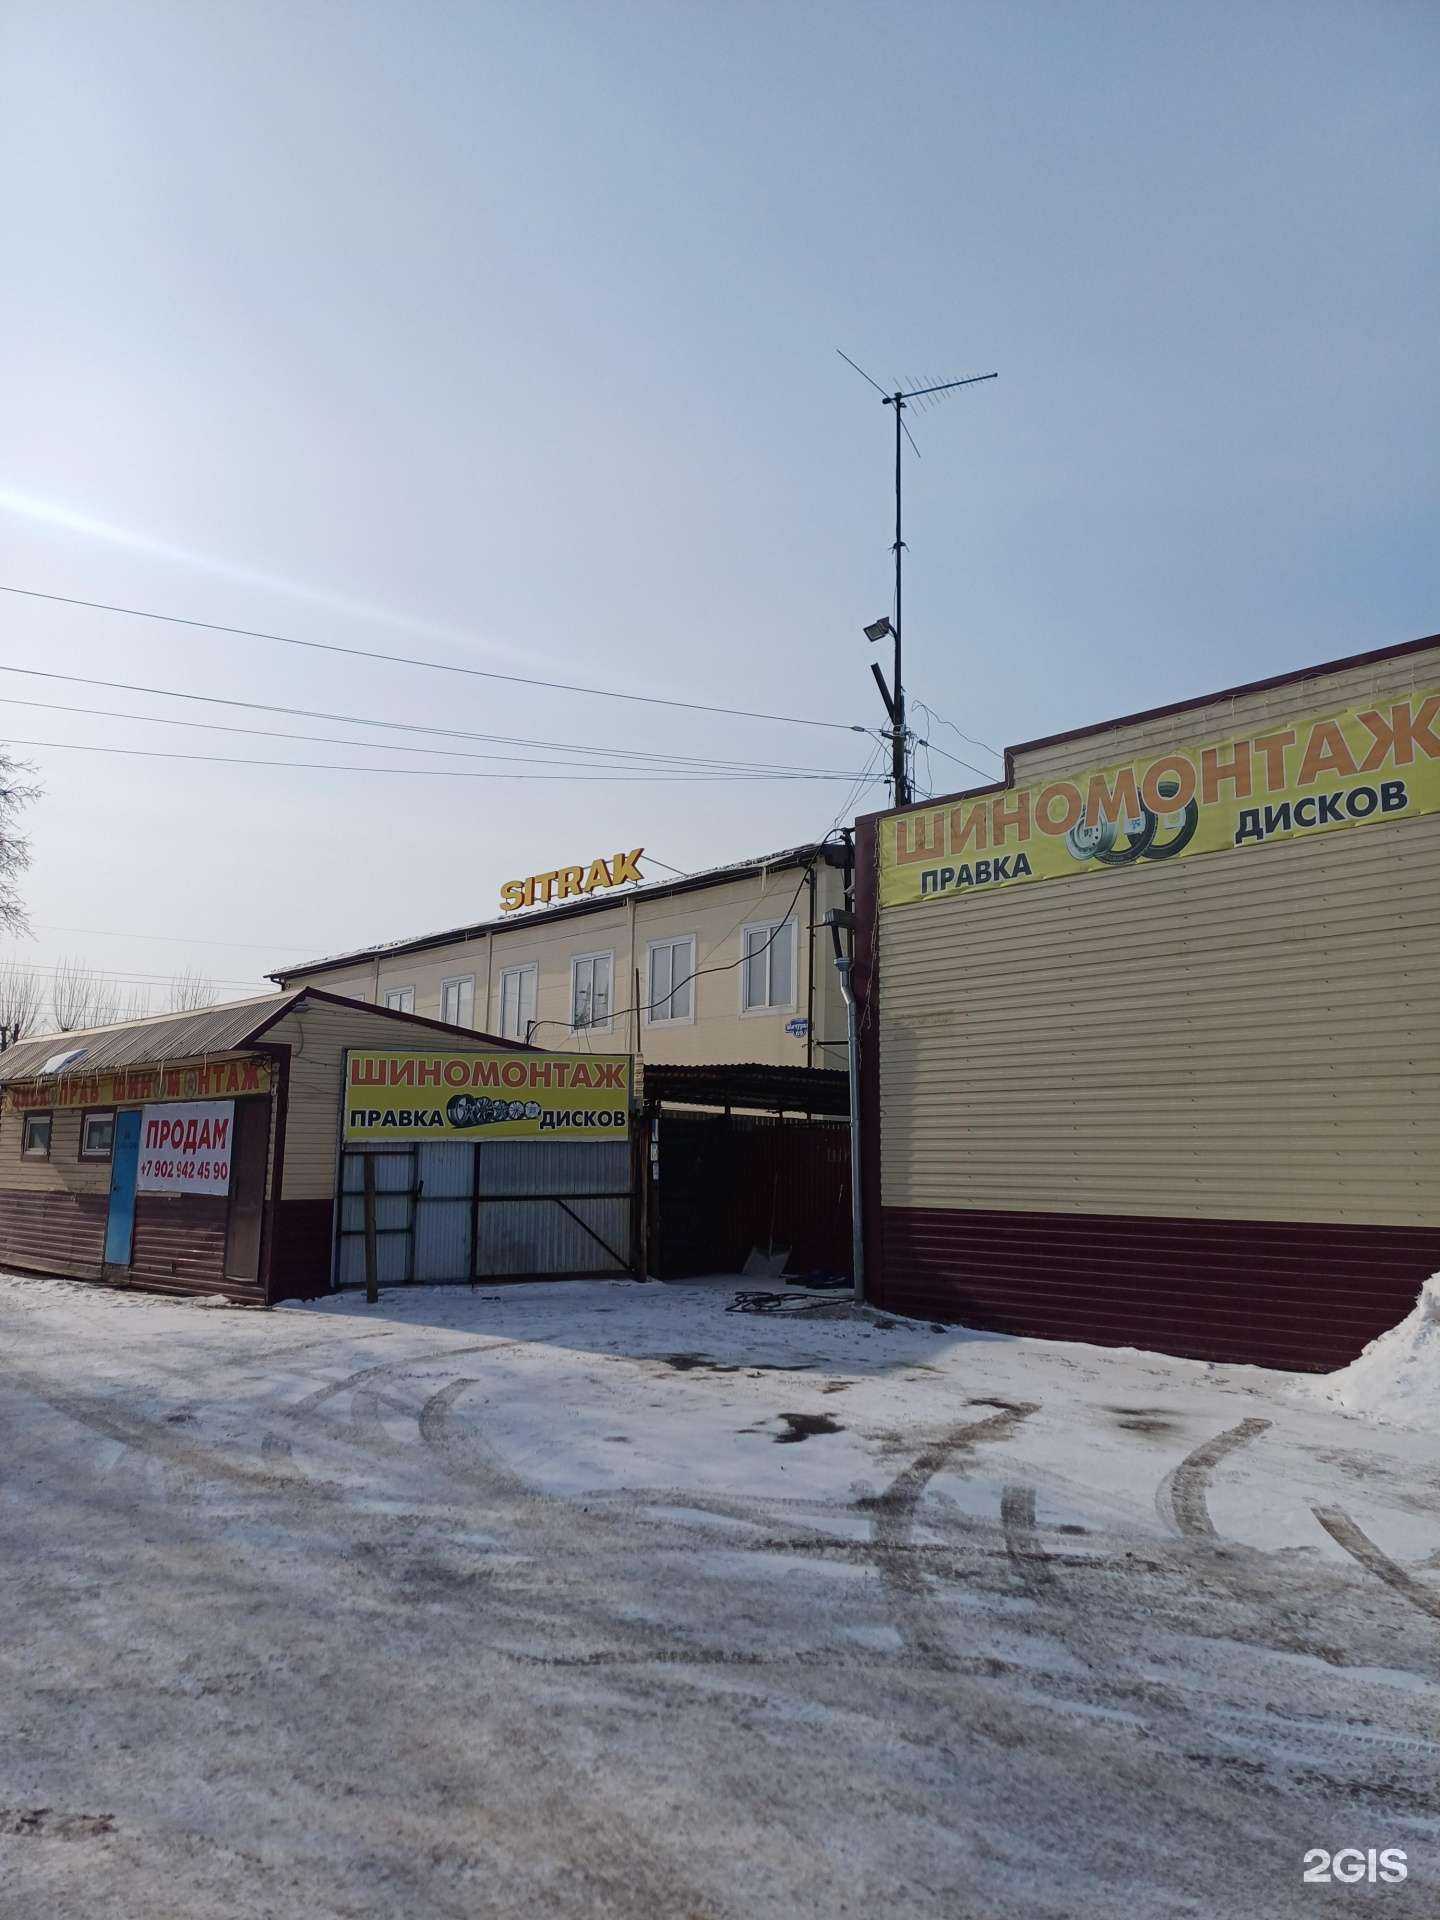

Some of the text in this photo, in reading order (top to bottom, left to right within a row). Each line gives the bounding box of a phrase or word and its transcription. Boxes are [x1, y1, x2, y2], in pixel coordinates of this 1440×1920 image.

[895, 696, 1440, 866] ШИНОМОНТАЖ
[920, 780, 1408, 895] ПРАВКА ДИСКОВ
[499, 847, 645, 911] SITRAK
[112, 1062, 260, 1101] ШИНОМОНТАЖ
[350, 1058, 626, 1088] ШИНОМОНТАЖ
[145, 1118, 229, 1155] ПРОДАМ
[350, 1109, 626, 1130] ПРАВКА ДИСКОВ
[141, 1159, 228, 1180] +7 902 942 45 90
